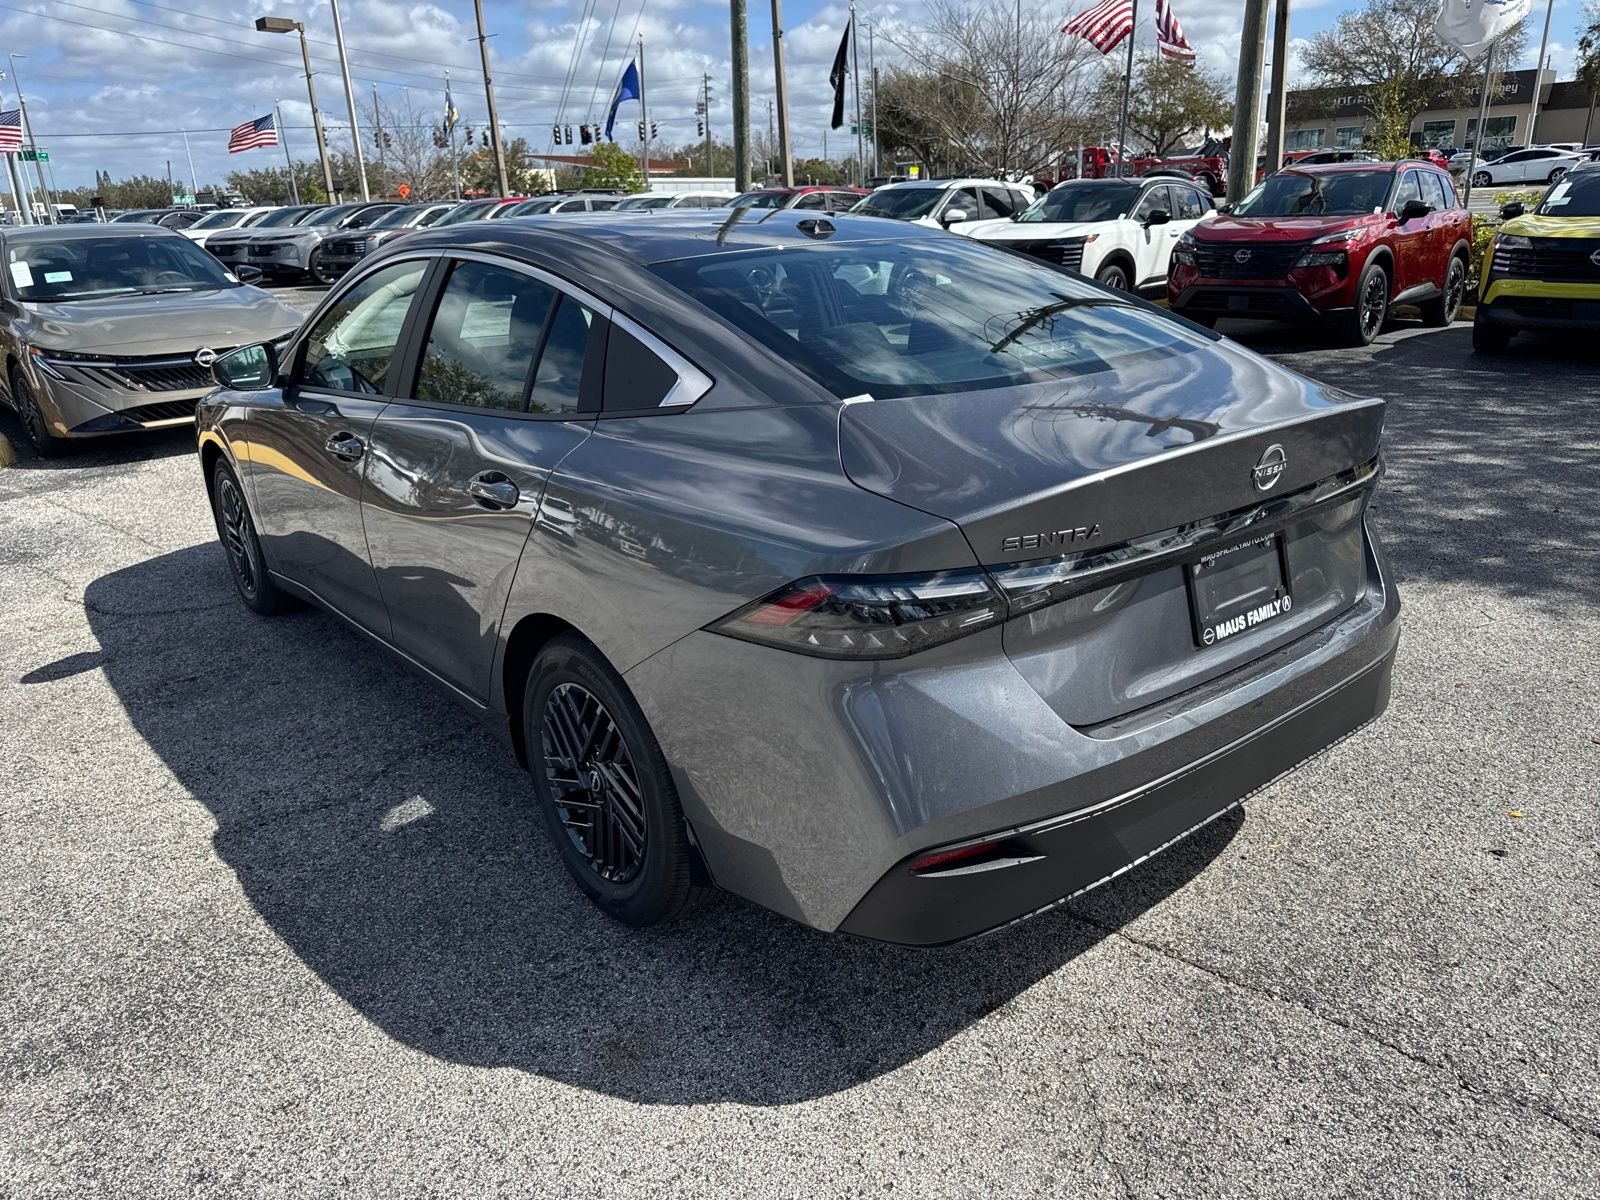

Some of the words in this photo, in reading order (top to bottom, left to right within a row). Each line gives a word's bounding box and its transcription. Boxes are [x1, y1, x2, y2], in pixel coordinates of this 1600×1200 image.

[1002, 525, 1100, 553] SENTRA
[1215, 615, 1247, 640] MAUS
[1247, 599, 1281, 627] FAMILY
